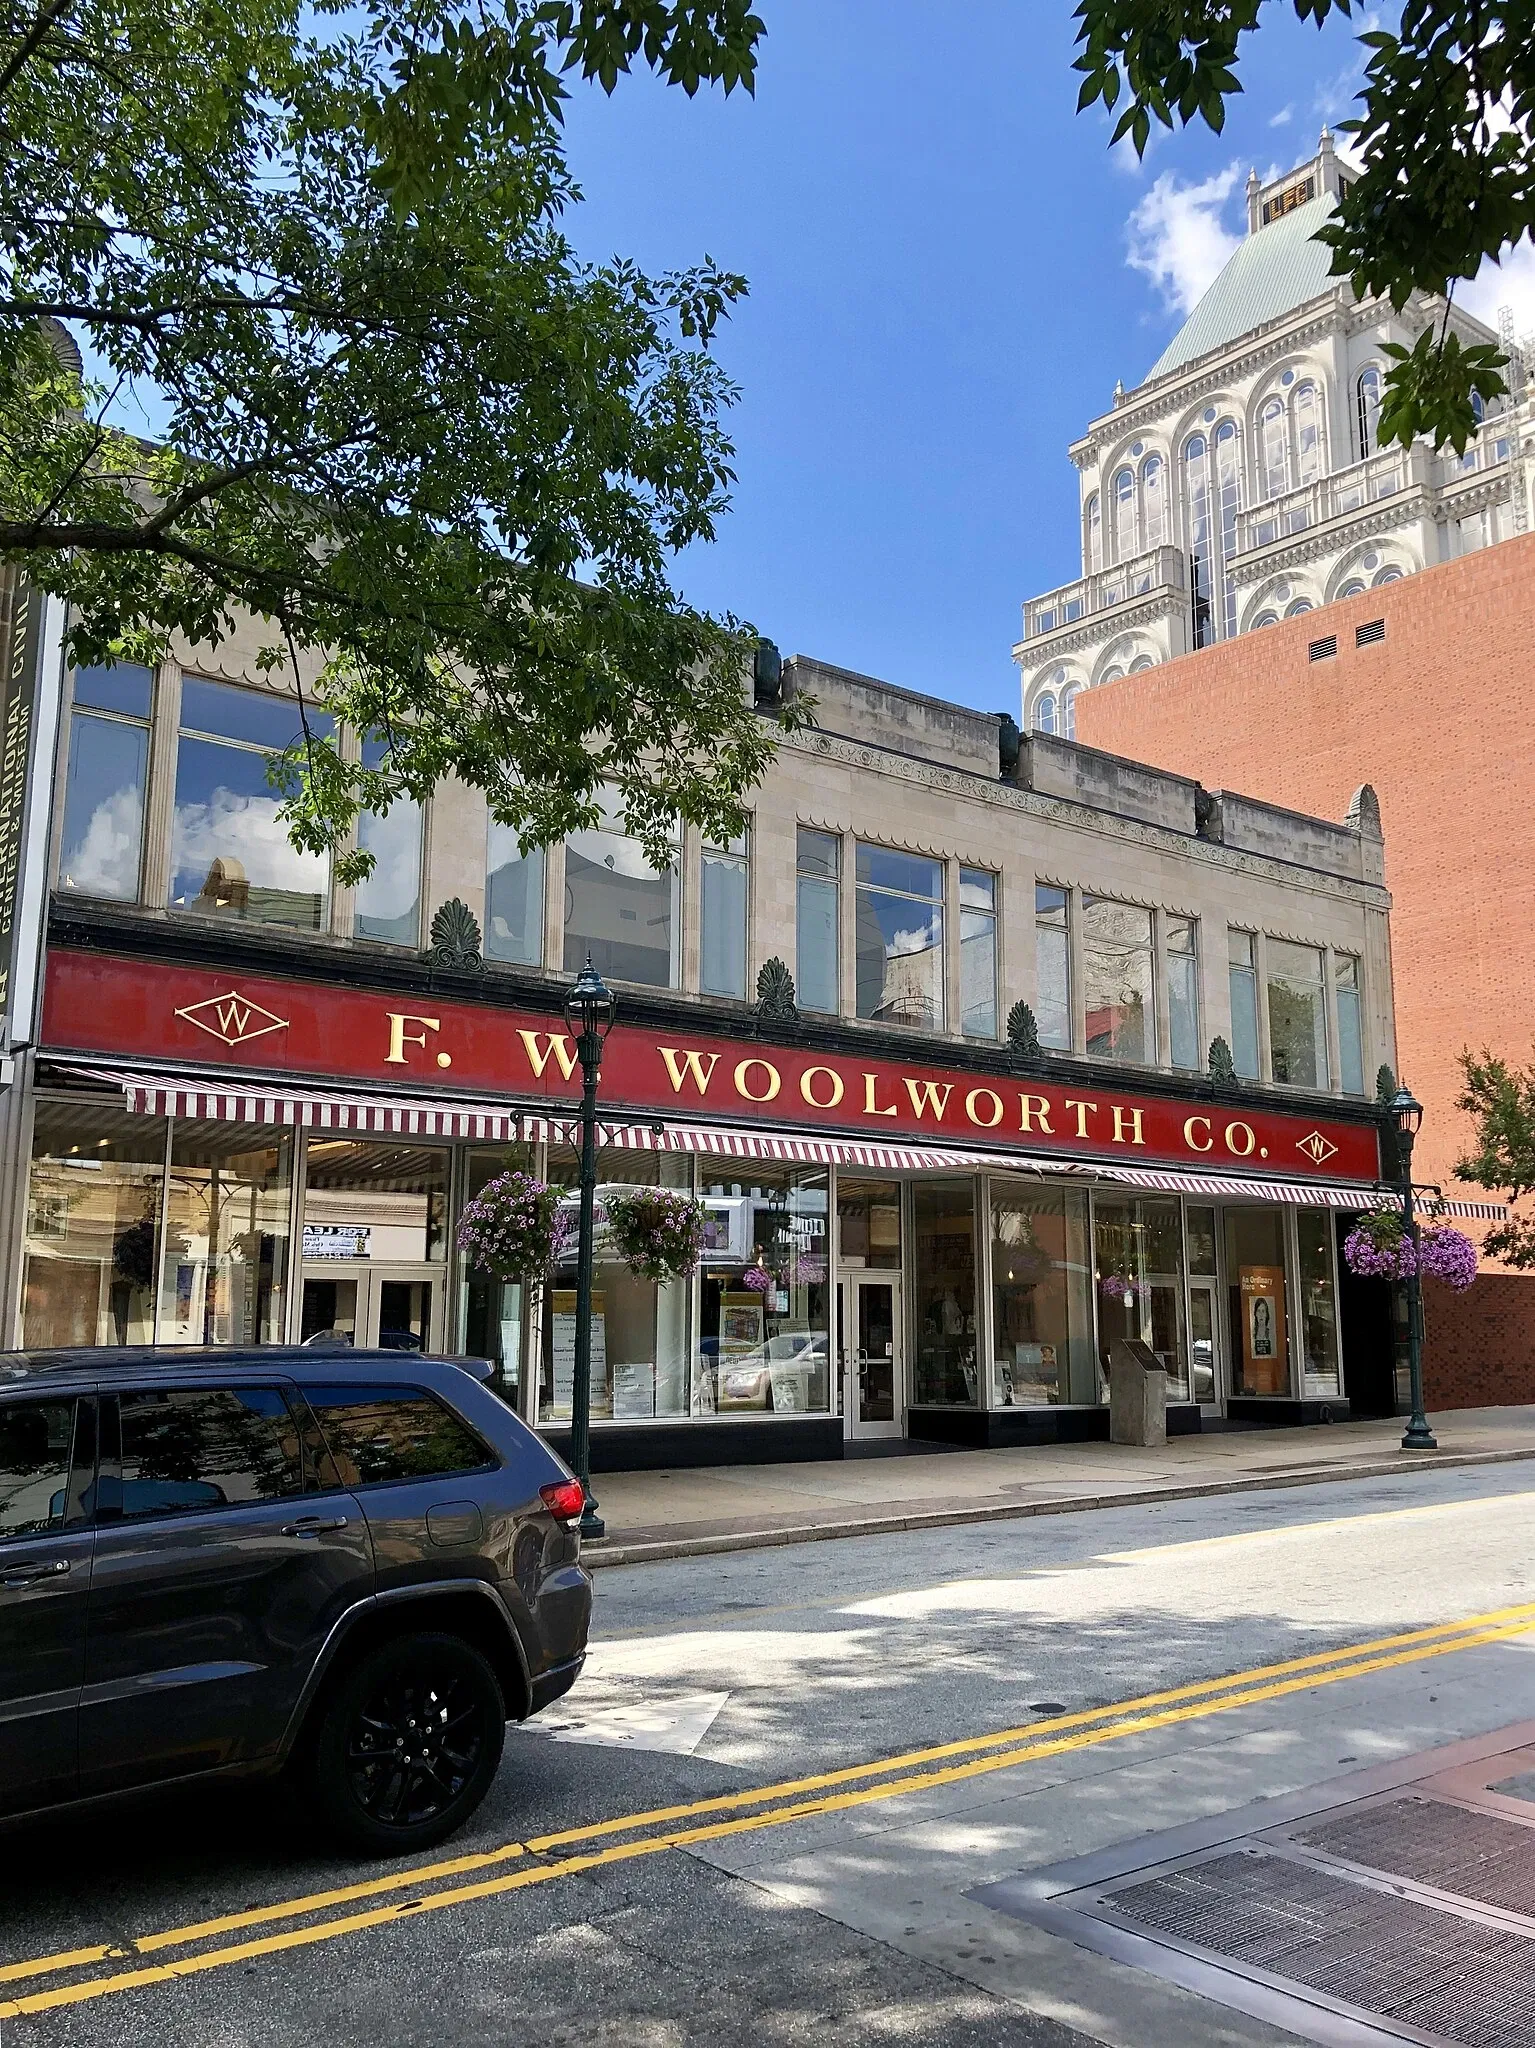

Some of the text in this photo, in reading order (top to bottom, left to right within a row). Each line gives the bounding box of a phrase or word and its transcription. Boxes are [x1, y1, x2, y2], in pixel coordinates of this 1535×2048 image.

[11, 591, 30, 680] CIVIL
[1, 704, 30, 935] CENTER & MUSEUM
[215, 1000, 252, 1036] W
[383, 1012, 1269, 1159] F. W WOOLWORTH CO.
[1309, 1136, 1325, 1157] W
